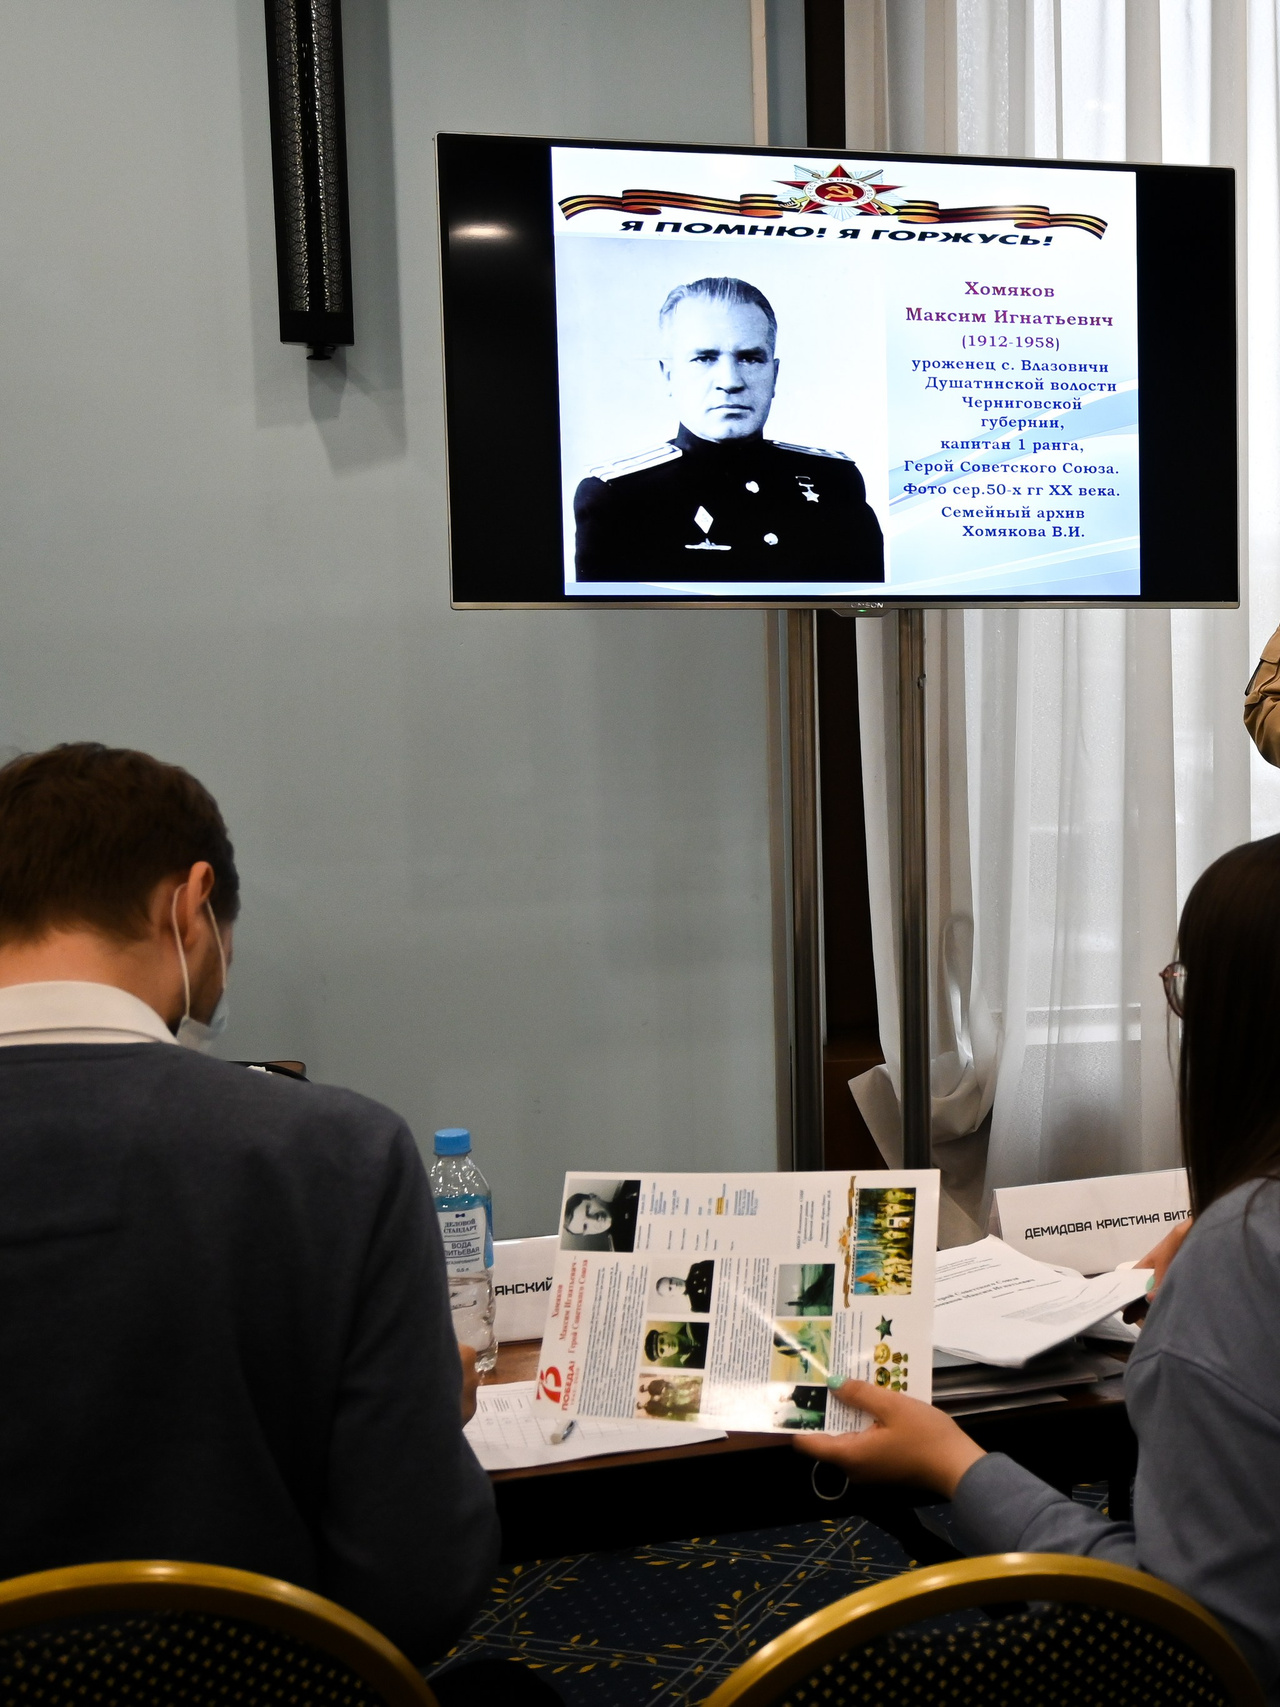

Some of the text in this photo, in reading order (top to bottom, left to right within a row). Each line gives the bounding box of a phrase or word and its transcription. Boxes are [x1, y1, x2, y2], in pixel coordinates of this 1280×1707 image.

[620, 220, 1053, 246] Я ПОМНЮ! Я ГОРЖУСЬ!
[965, 281, 1055, 297] Хомяков
[905, 307, 1113, 327] Максим Игнатьевич
[962, 335, 1060, 351] (1912-1958)
[911, 359, 1109, 373] уроженец с. Влазовичи
[925, 376, 1117, 392] Душатинской волости
[962, 396, 1082, 411] Черниговской
[981, 416, 1065, 431] губернии,
[940, 439, 1084, 454] капитан 1 ранга,
[904, 459, 1119, 475] Герой Советского Союза.
[903, 483, 947, 495] Фото
[1027, 486, 1043, 496] гг
[1078, 486, 1120, 497] века.
[941, 506, 1085, 522] Семейный архив
[962, 525, 1085, 538] Хомякова В.И.
[1025, 1221, 1093, 1240] ДЕМИДОВА
[1096, 1213, 1160, 1230] КРИСТИНА
[451, 1241, 472, 1250] ВОДА
[561, 1360, 576, 1411] ПОБЕДА!
